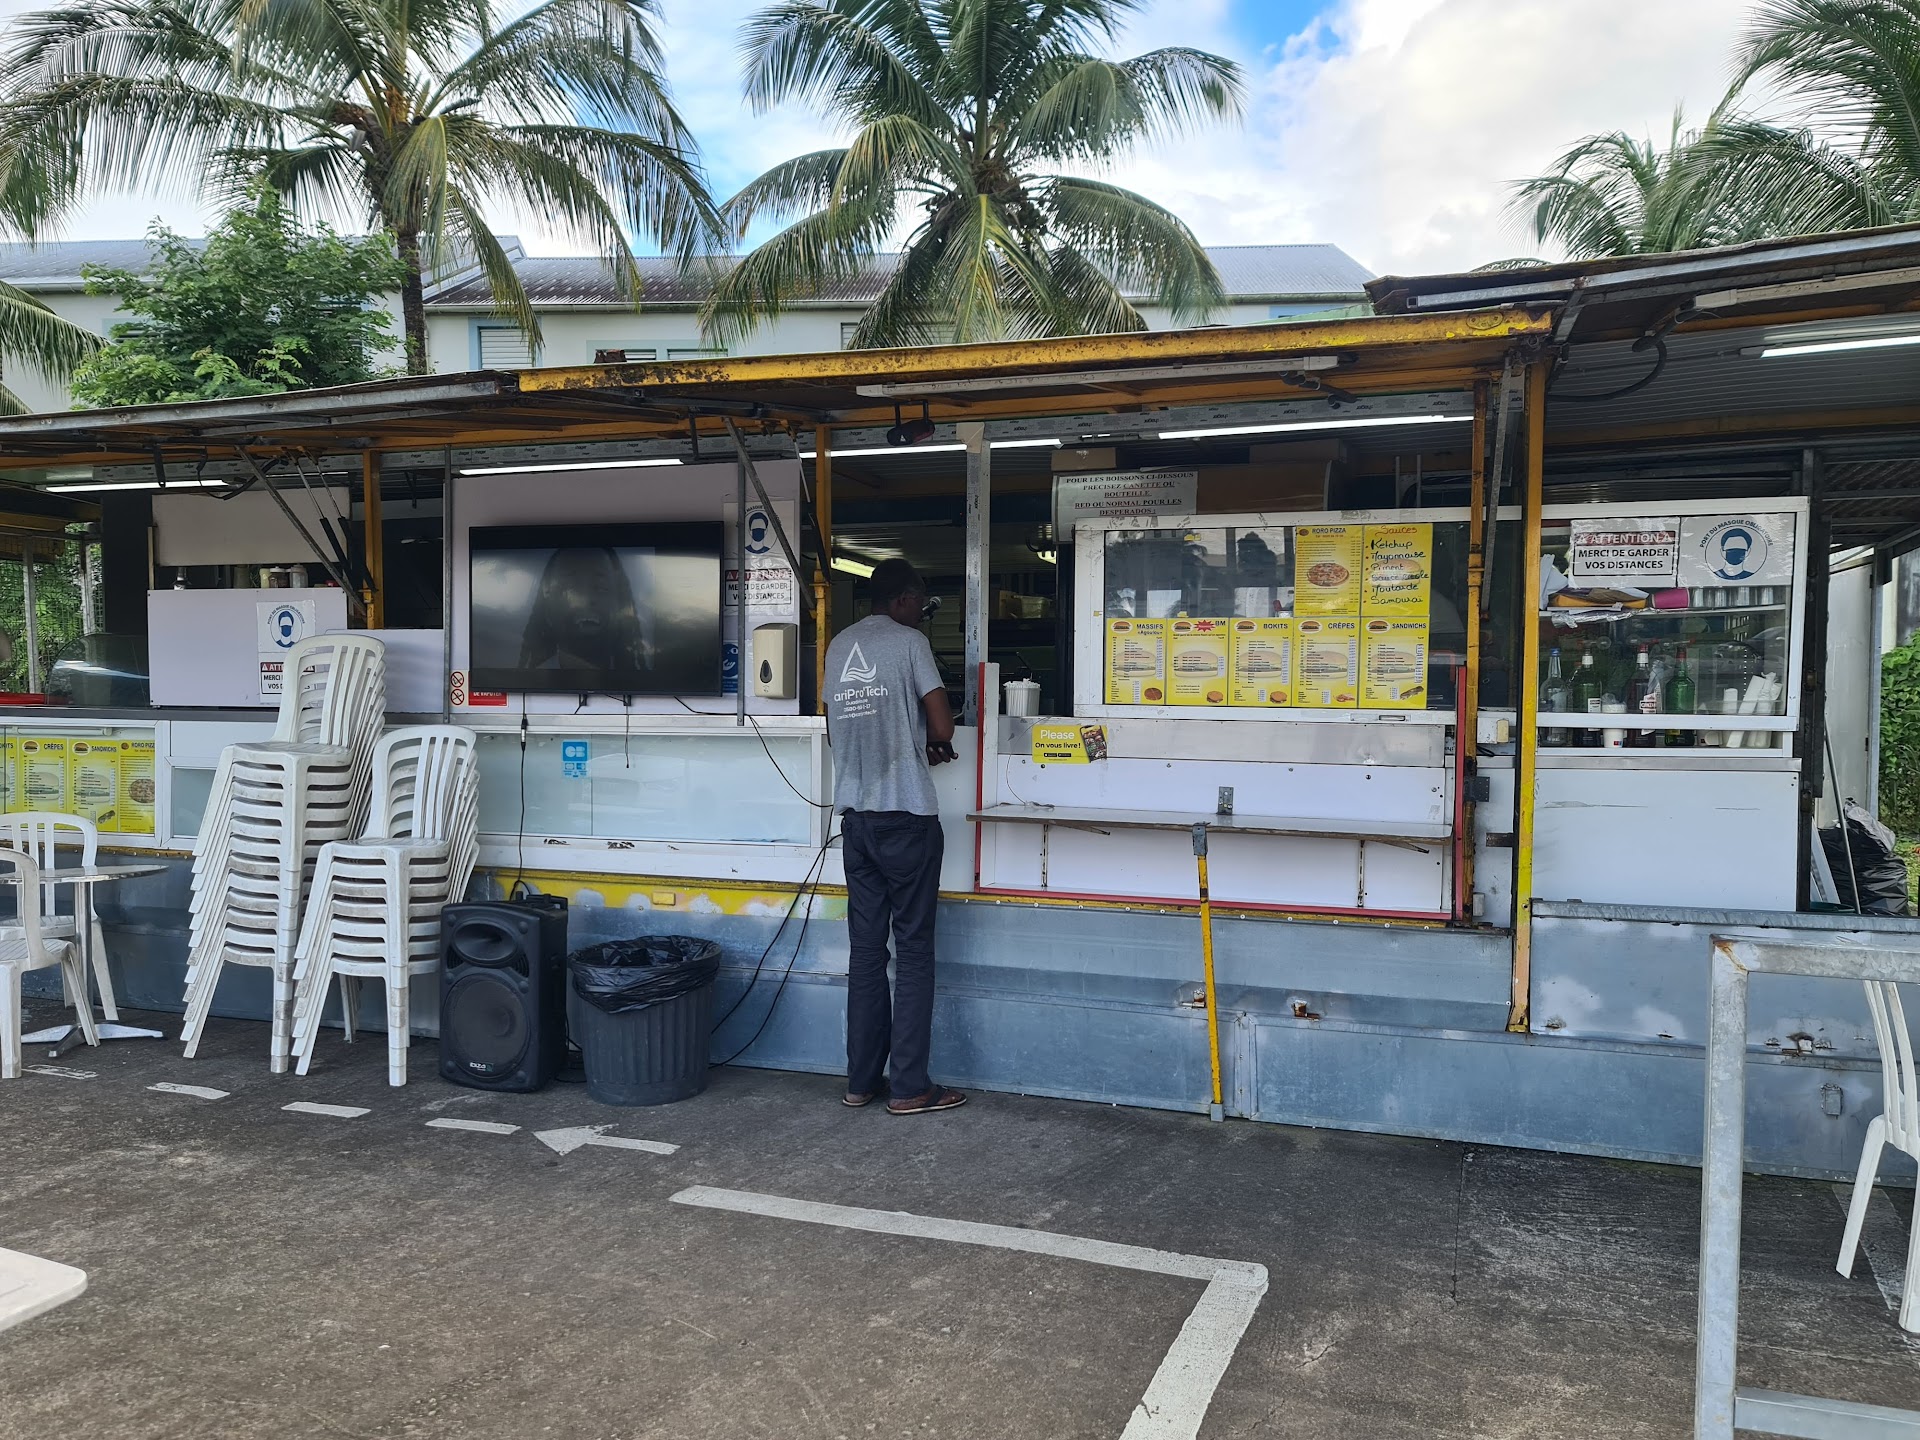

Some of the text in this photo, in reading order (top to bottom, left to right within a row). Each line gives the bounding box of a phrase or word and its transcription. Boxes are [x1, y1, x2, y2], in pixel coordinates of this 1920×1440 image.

[1375, 525, 1418, 536] Sauces
[1700, 519, 1774, 548] PORT DU MASQUE OBLIGATOIRE
[1371, 538, 1413, 550] Ketchup
[1590, 534, 1659, 544] ATTENTION
[1578, 549, 1609, 557] MERCI
[1371, 562, 1404, 571] Piment
[1608, 560, 1663, 569] DISTANCES
[1372, 573, 1400, 582] Sauce
[1372, 583, 1419, 596] Moutarde
[1040, 730, 1075, 739] Please
[565, 746, 585, 758] CB
